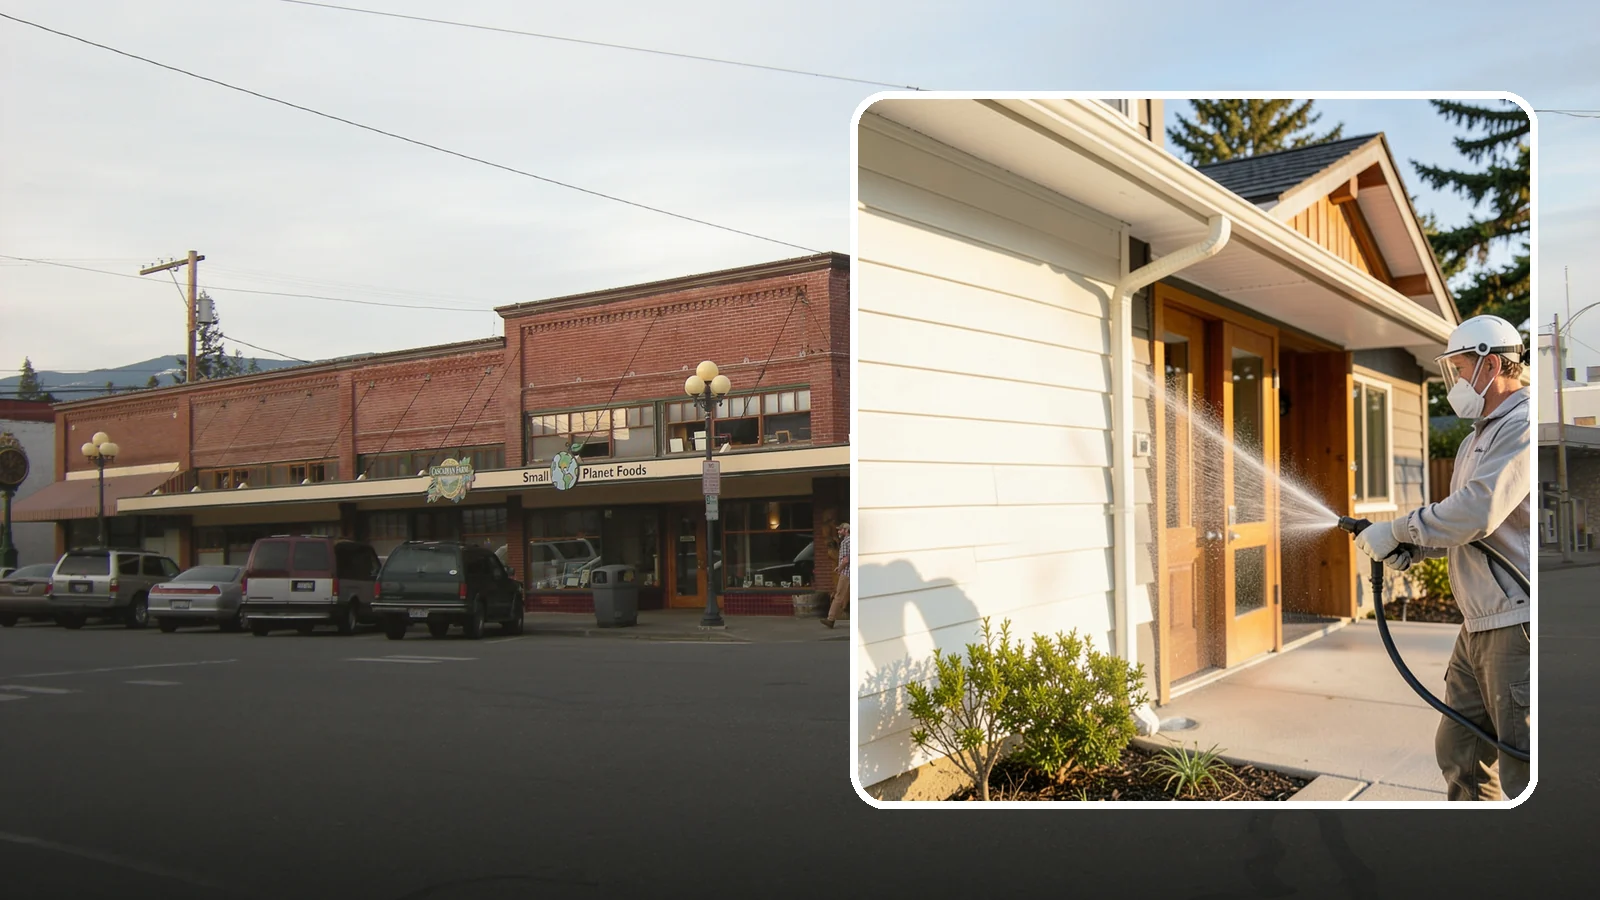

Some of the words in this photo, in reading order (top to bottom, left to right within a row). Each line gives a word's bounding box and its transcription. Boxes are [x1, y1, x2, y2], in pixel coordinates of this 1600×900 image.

[431, 467, 455, 476] CASCADIAN
[523, 471, 549, 483] Small
[583, 468, 614, 479] Planet
[617, 465, 647, 477] Foods
